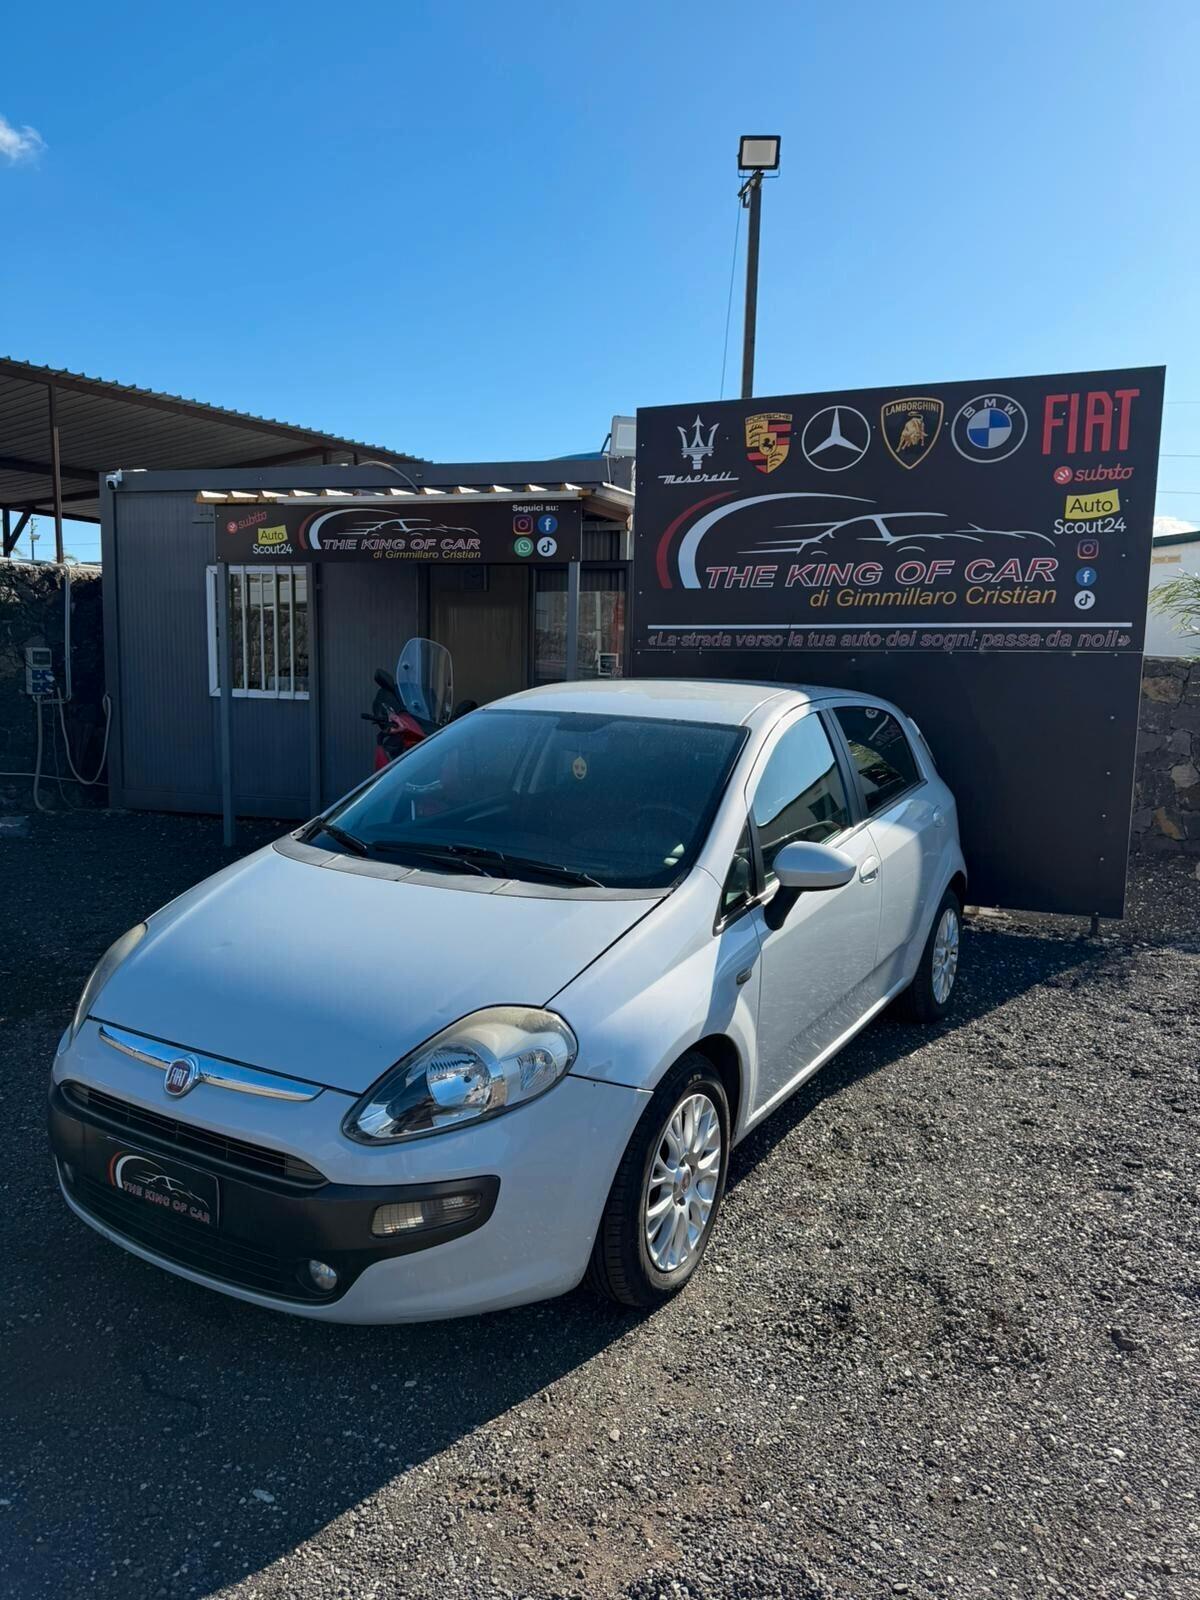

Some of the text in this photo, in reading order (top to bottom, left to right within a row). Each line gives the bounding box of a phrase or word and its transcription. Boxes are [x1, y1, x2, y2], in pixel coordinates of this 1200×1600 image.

[885, 401, 940, 416] LAMBORGHINI
[962, 397, 1018, 419] BMW
[1042, 389, 1140, 455] FIAT
[1074, 463, 1135, 482] subito
[512, 504, 560, 512] Seguici su:
[1069, 499, 1113, 515] Auto
[238, 511, 268, 530] subito
[1053, 517, 1127, 535] Scout24
[260, 530, 285, 541] Auto
[323, 538, 481, 549] THE KING OF CAR
[252, 544, 293, 554] Scout24
[385, 550, 439, 558] Gimmillaro
[442, 550, 481, 558] Cristian
[706, 557, 1059, 588] THE KING OF CAR
[810, 586, 1057, 607] di Gimmillaro Cristian
[680, 632, 732, 647] strada
[735, 633, 783, 647] verso
[787, 631, 803, 646] la
[807, 632, 836, 646] tua
[840, 631, 881, 647] auto
[886, 630, 917, 646] dei
[920, 630, 976, 650] sogni
[979, 632, 1041, 653] passa
[1045, 630, 1072, 647] da
[169, 1067, 188, 1086] FIAT
[123, 1180, 210, 1225] THE KING OF CAR
